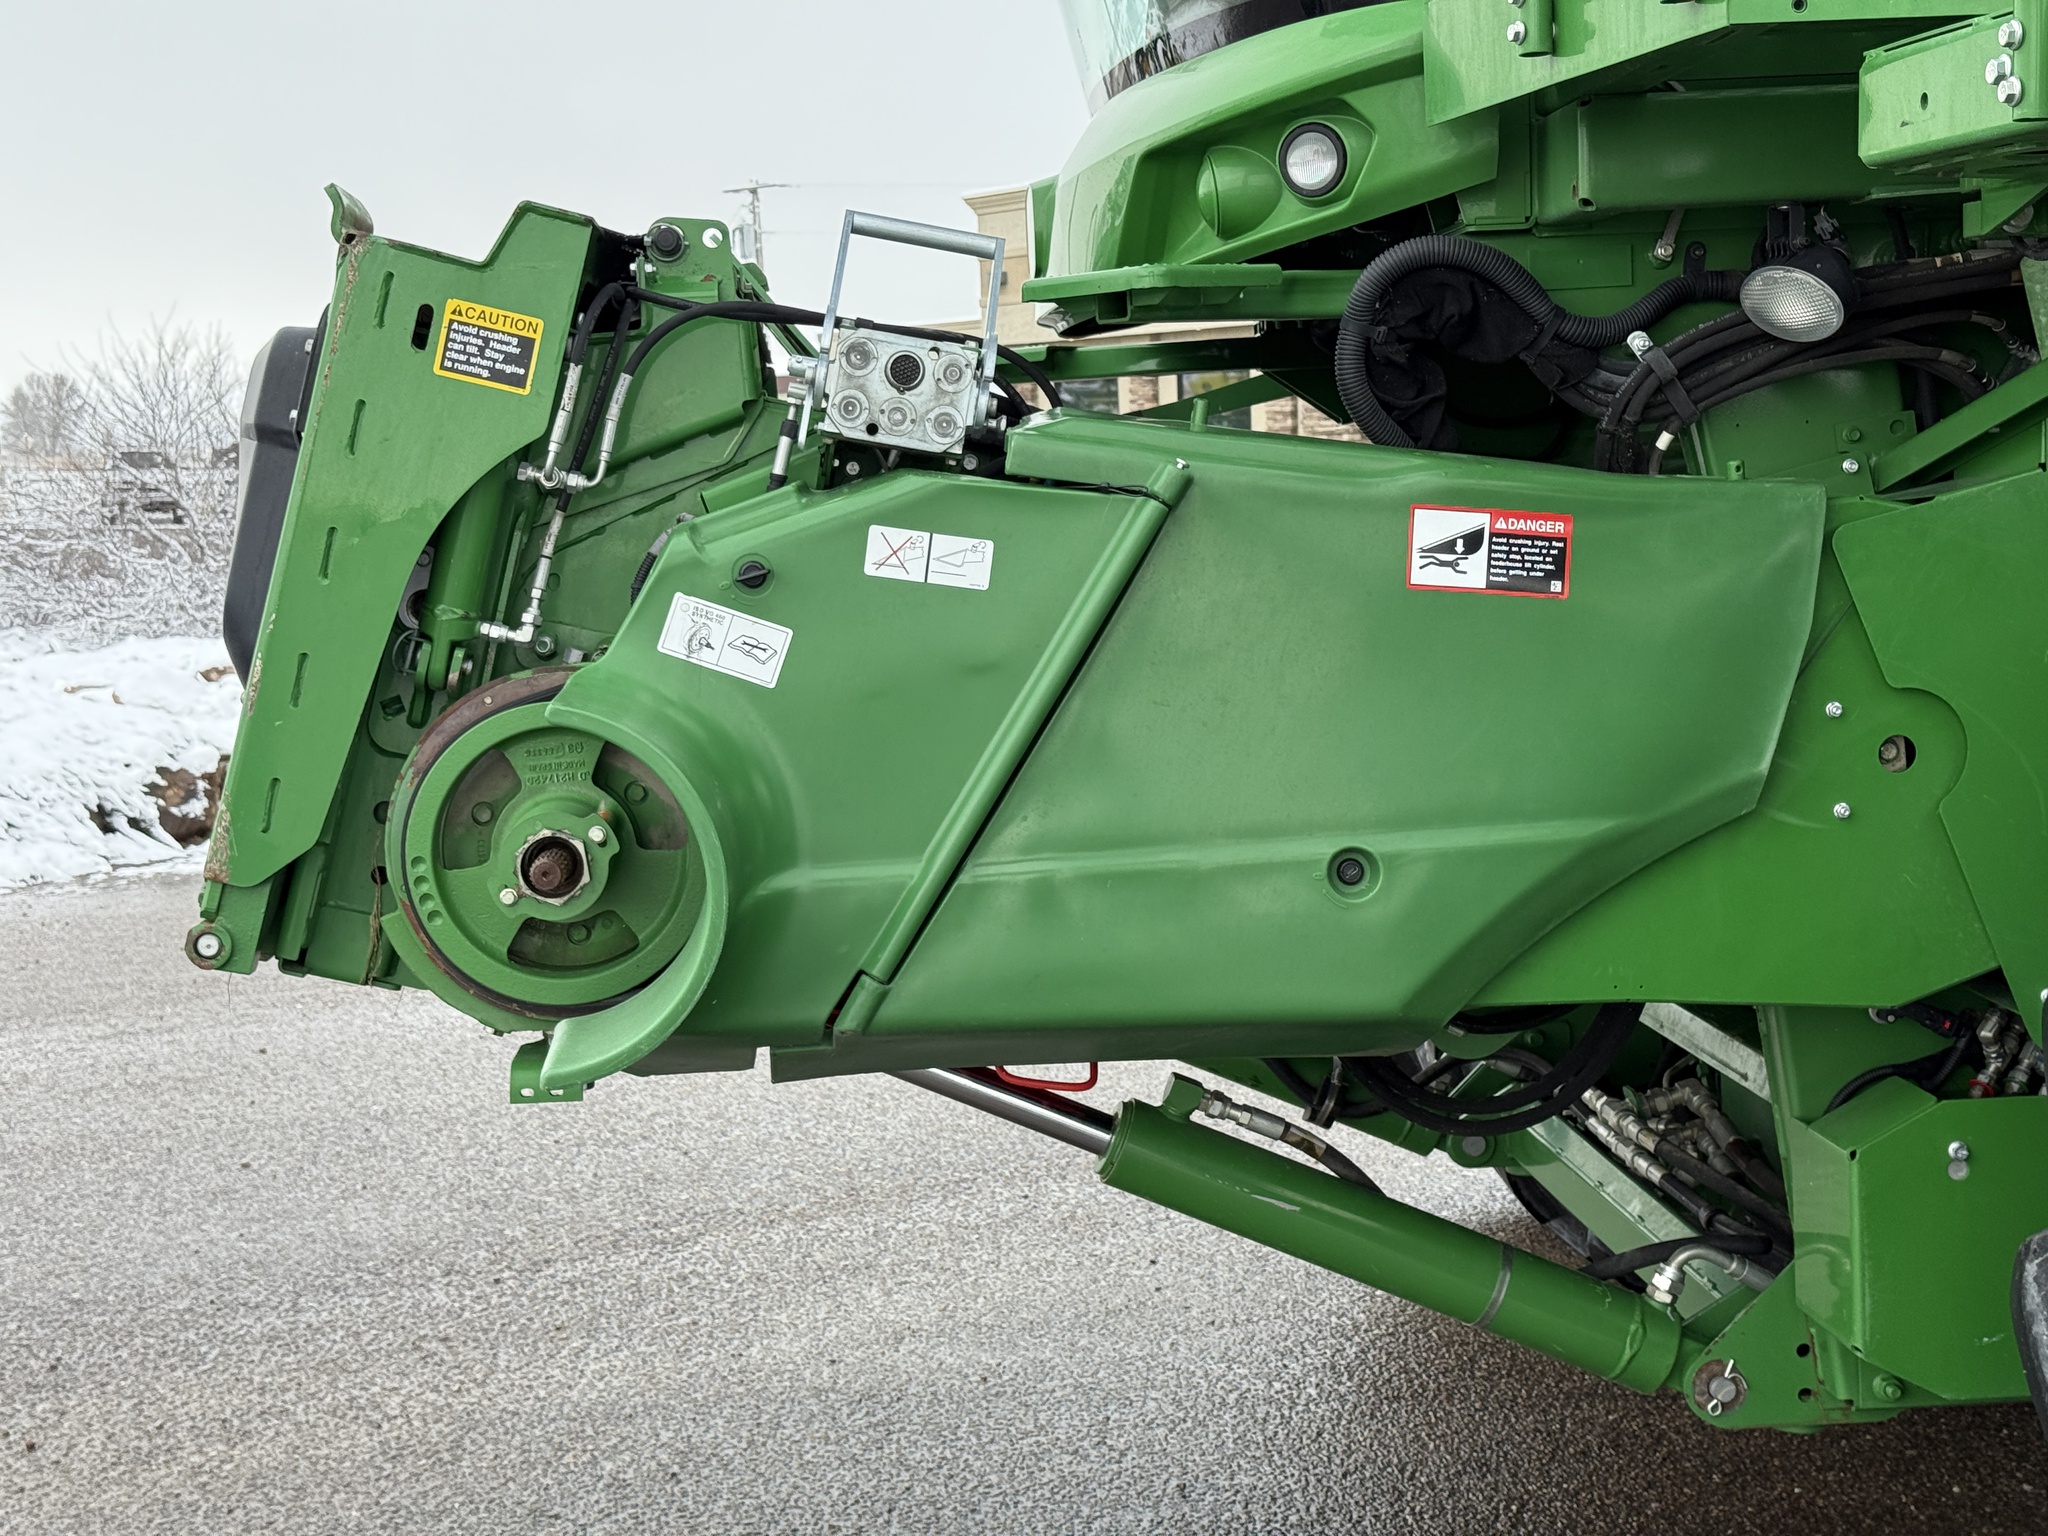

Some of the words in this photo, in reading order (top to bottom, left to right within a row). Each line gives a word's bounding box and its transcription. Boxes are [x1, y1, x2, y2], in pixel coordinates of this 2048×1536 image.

[465, 307, 539, 334] CAUTION
[450, 331, 485, 346] injuries.
[489, 340, 521, 354] Header
[451, 322, 478, 335] Avoid
[480, 329, 518, 345] crushing
[447, 342, 464, 350] can
[466, 345, 480, 354] tilt.
[484, 350, 505, 361] Stay
[444, 359, 452, 367] is
[454, 363, 491, 377] running.
[446, 351, 468, 361] clear
[470, 356, 493, 367] when
[495, 363, 525, 375] engine
[1508, 518, 1564, 533] DANGER
[1509, 538, 1532, 546] crushing
